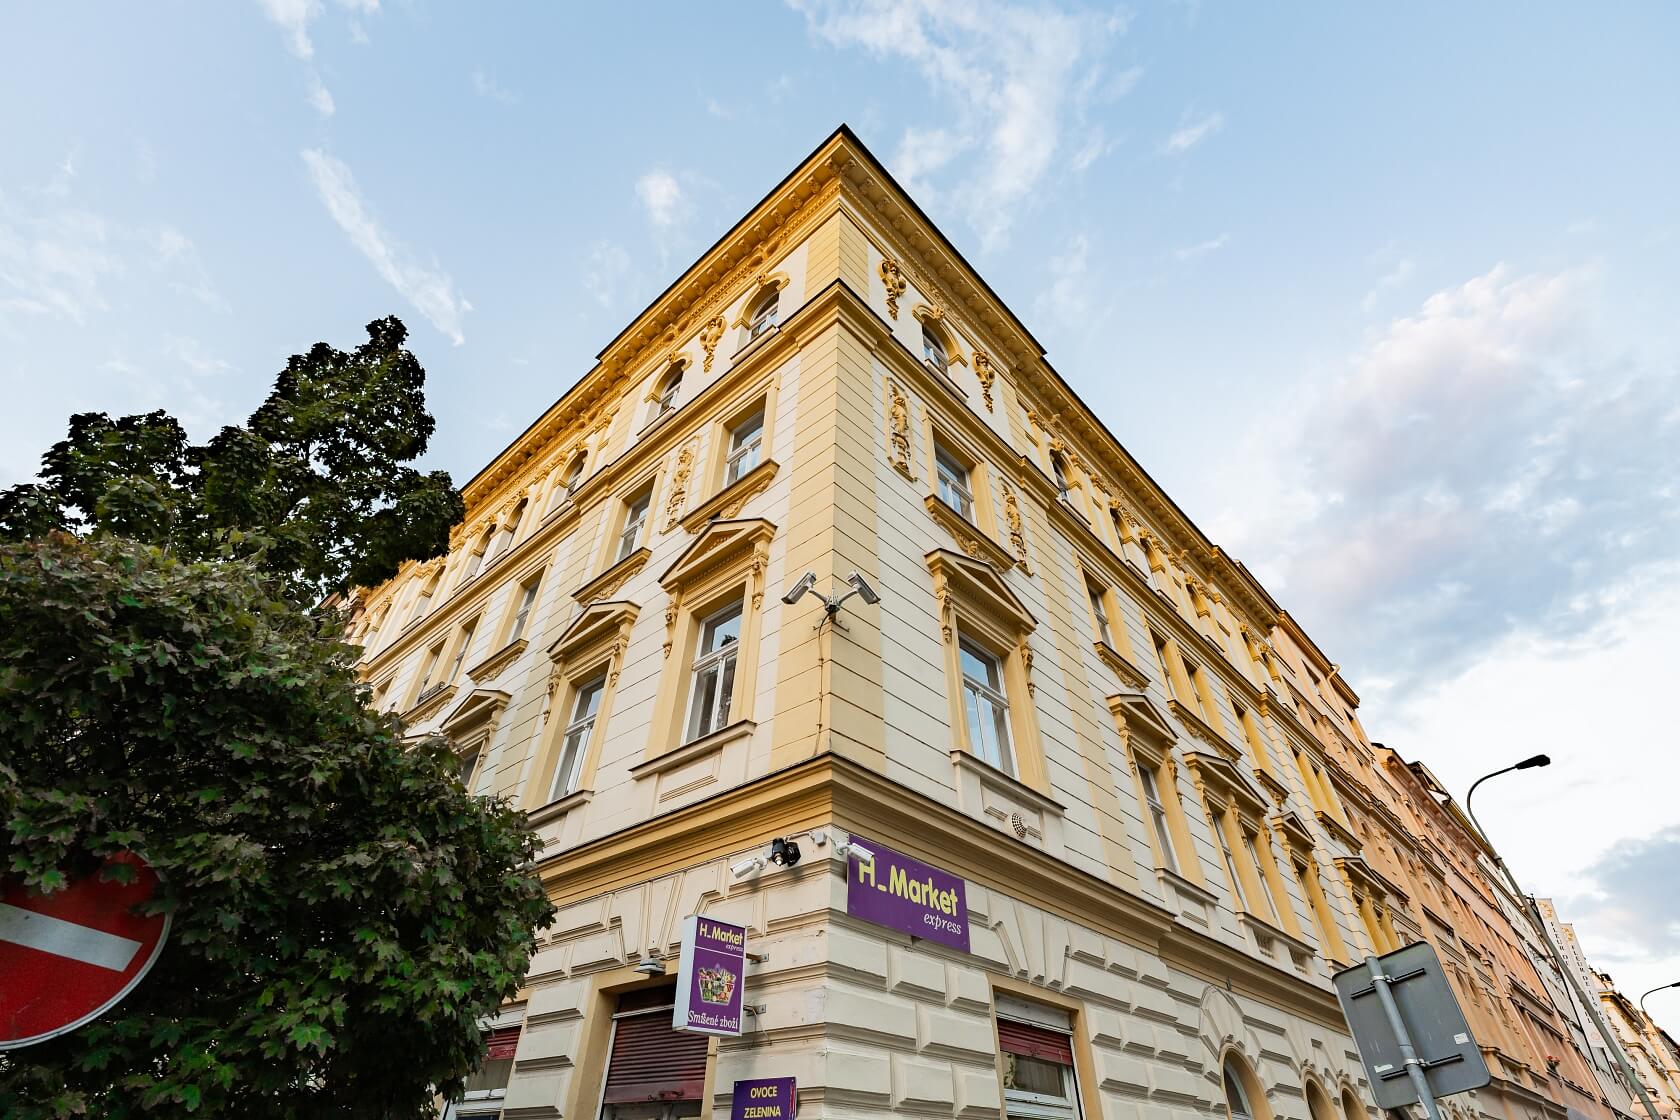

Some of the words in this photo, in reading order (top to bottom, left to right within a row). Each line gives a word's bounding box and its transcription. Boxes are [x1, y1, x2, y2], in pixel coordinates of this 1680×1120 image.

[858, 856, 958, 917] H_Market
[924, 913, 962, 935] express
[700, 922, 743, 945] H_Market
[720, 1015, 739, 1029] zboží
[750, 1085, 778, 1099] OVOCE
[744, 1105, 782, 1119] ZELENINA
